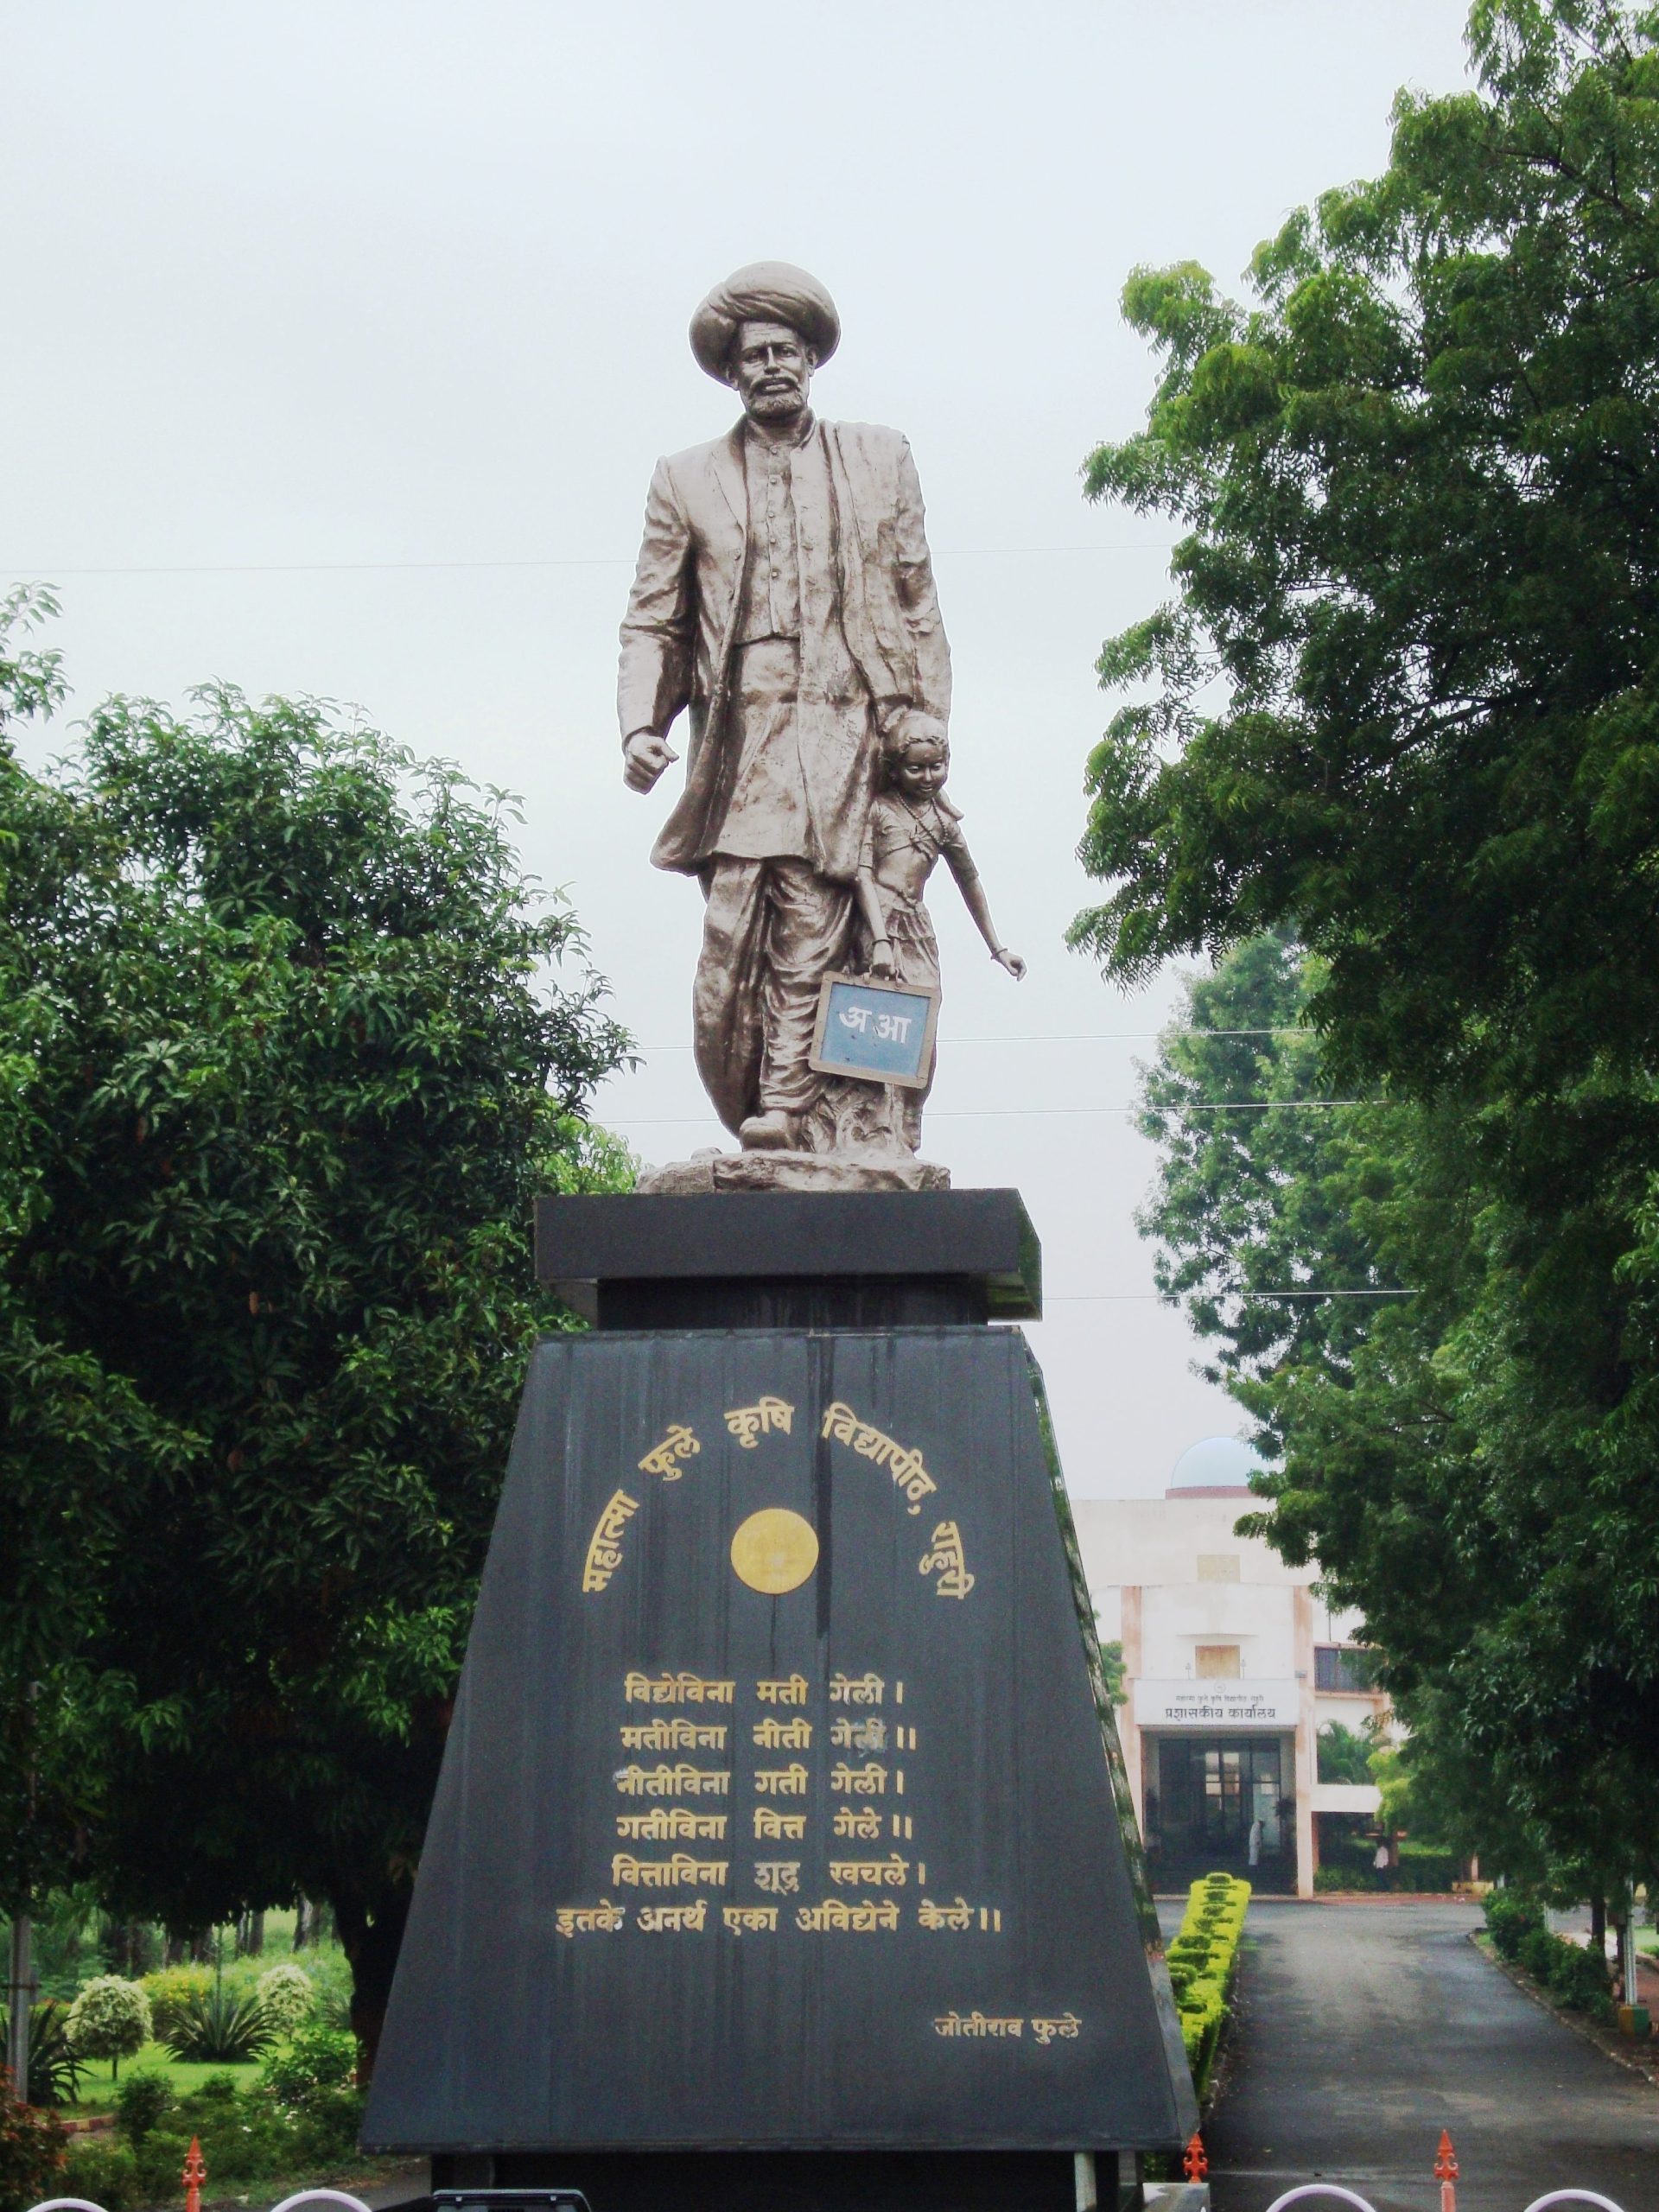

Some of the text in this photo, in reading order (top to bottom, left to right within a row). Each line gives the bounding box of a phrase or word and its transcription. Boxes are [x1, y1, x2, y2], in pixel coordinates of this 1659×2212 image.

[582, 1395, 976, 1600] महात्मा फुले कृषि विद्यापीठ, राहुरी
[623, 1671, 736, 1704] विद्येविना
[756, 1673, 810, 1706] मती
[829, 1672, 886, 1706] गेली
[1166, 1704, 1276, 1721] प्रशासकीय कार्यालय
[620, 1717, 728, 1751] मतीविना
[753, 1717, 813, 1750] नीती
[613, 1763, 731, 1796] नीतीविना
[753, 1762, 809, 1796] गती
[830, 1762, 888, 1795] गेली
[615, 1807, 728, 1840] गतीविना
[753, 1806, 807, 1840] वित्त
[833, 1806, 883, 1840] गेले
[611, 1853, 730, 1887] वित्ताविना
[753, 1861, 802, 1896] शूद्र
[829, 1853, 911, 1886] खचले
[555, 1898, 626, 1938] इतके
[636, 1898, 709, 1932] अनर्थ
[722, 1907, 779, 1936] एका
[794, 1898, 900, 1932] अविद्येने
[918, 1897, 976, 1931] केले
[933, 2011, 1083, 2045] जोतीराव फुले
